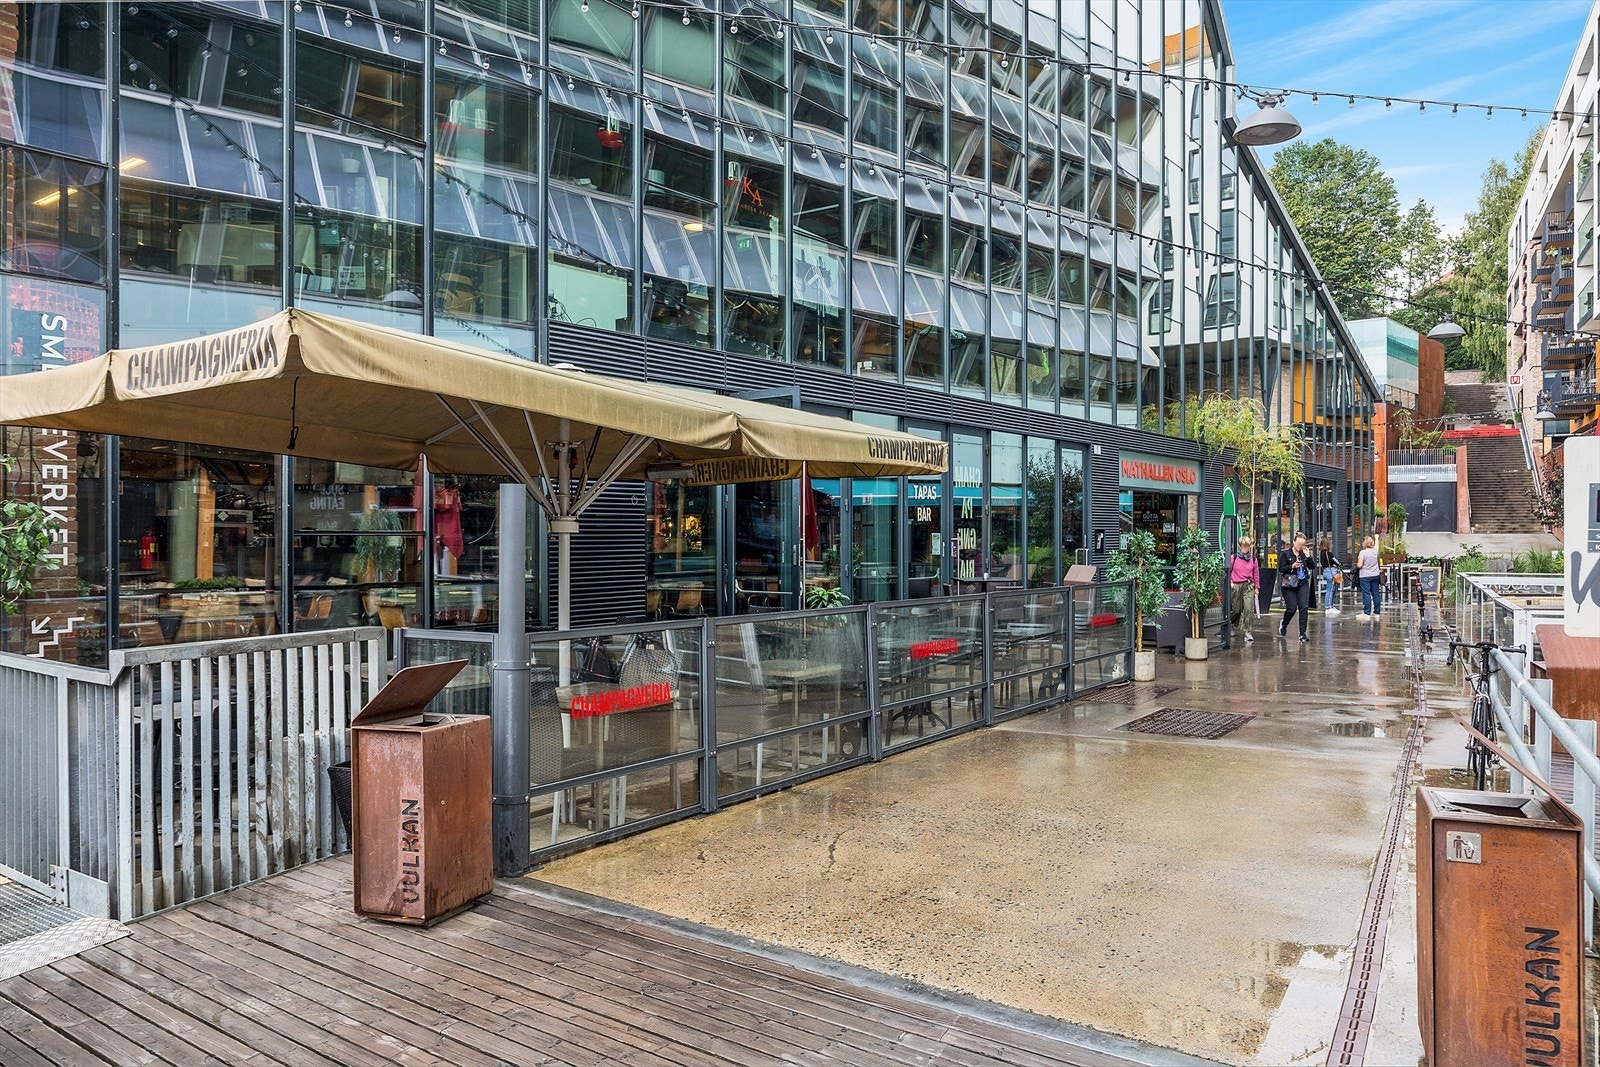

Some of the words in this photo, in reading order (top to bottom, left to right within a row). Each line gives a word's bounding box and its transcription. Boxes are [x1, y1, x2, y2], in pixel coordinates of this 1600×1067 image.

[127, 325, 279, 391] CHAMPAGNERIA
[1121, 460, 1174, 483] MATHALLEN
[1176, 466, 1197, 485] OSLO
[914, 485, 937, 500] TAPAS
[917, 507, 932, 522] BAR
[571, 681, 673, 720] CHAMPAGNERIA
[402, 799, 419, 904] VULKAN
[1525, 926, 1561, 1067] ULKAN
